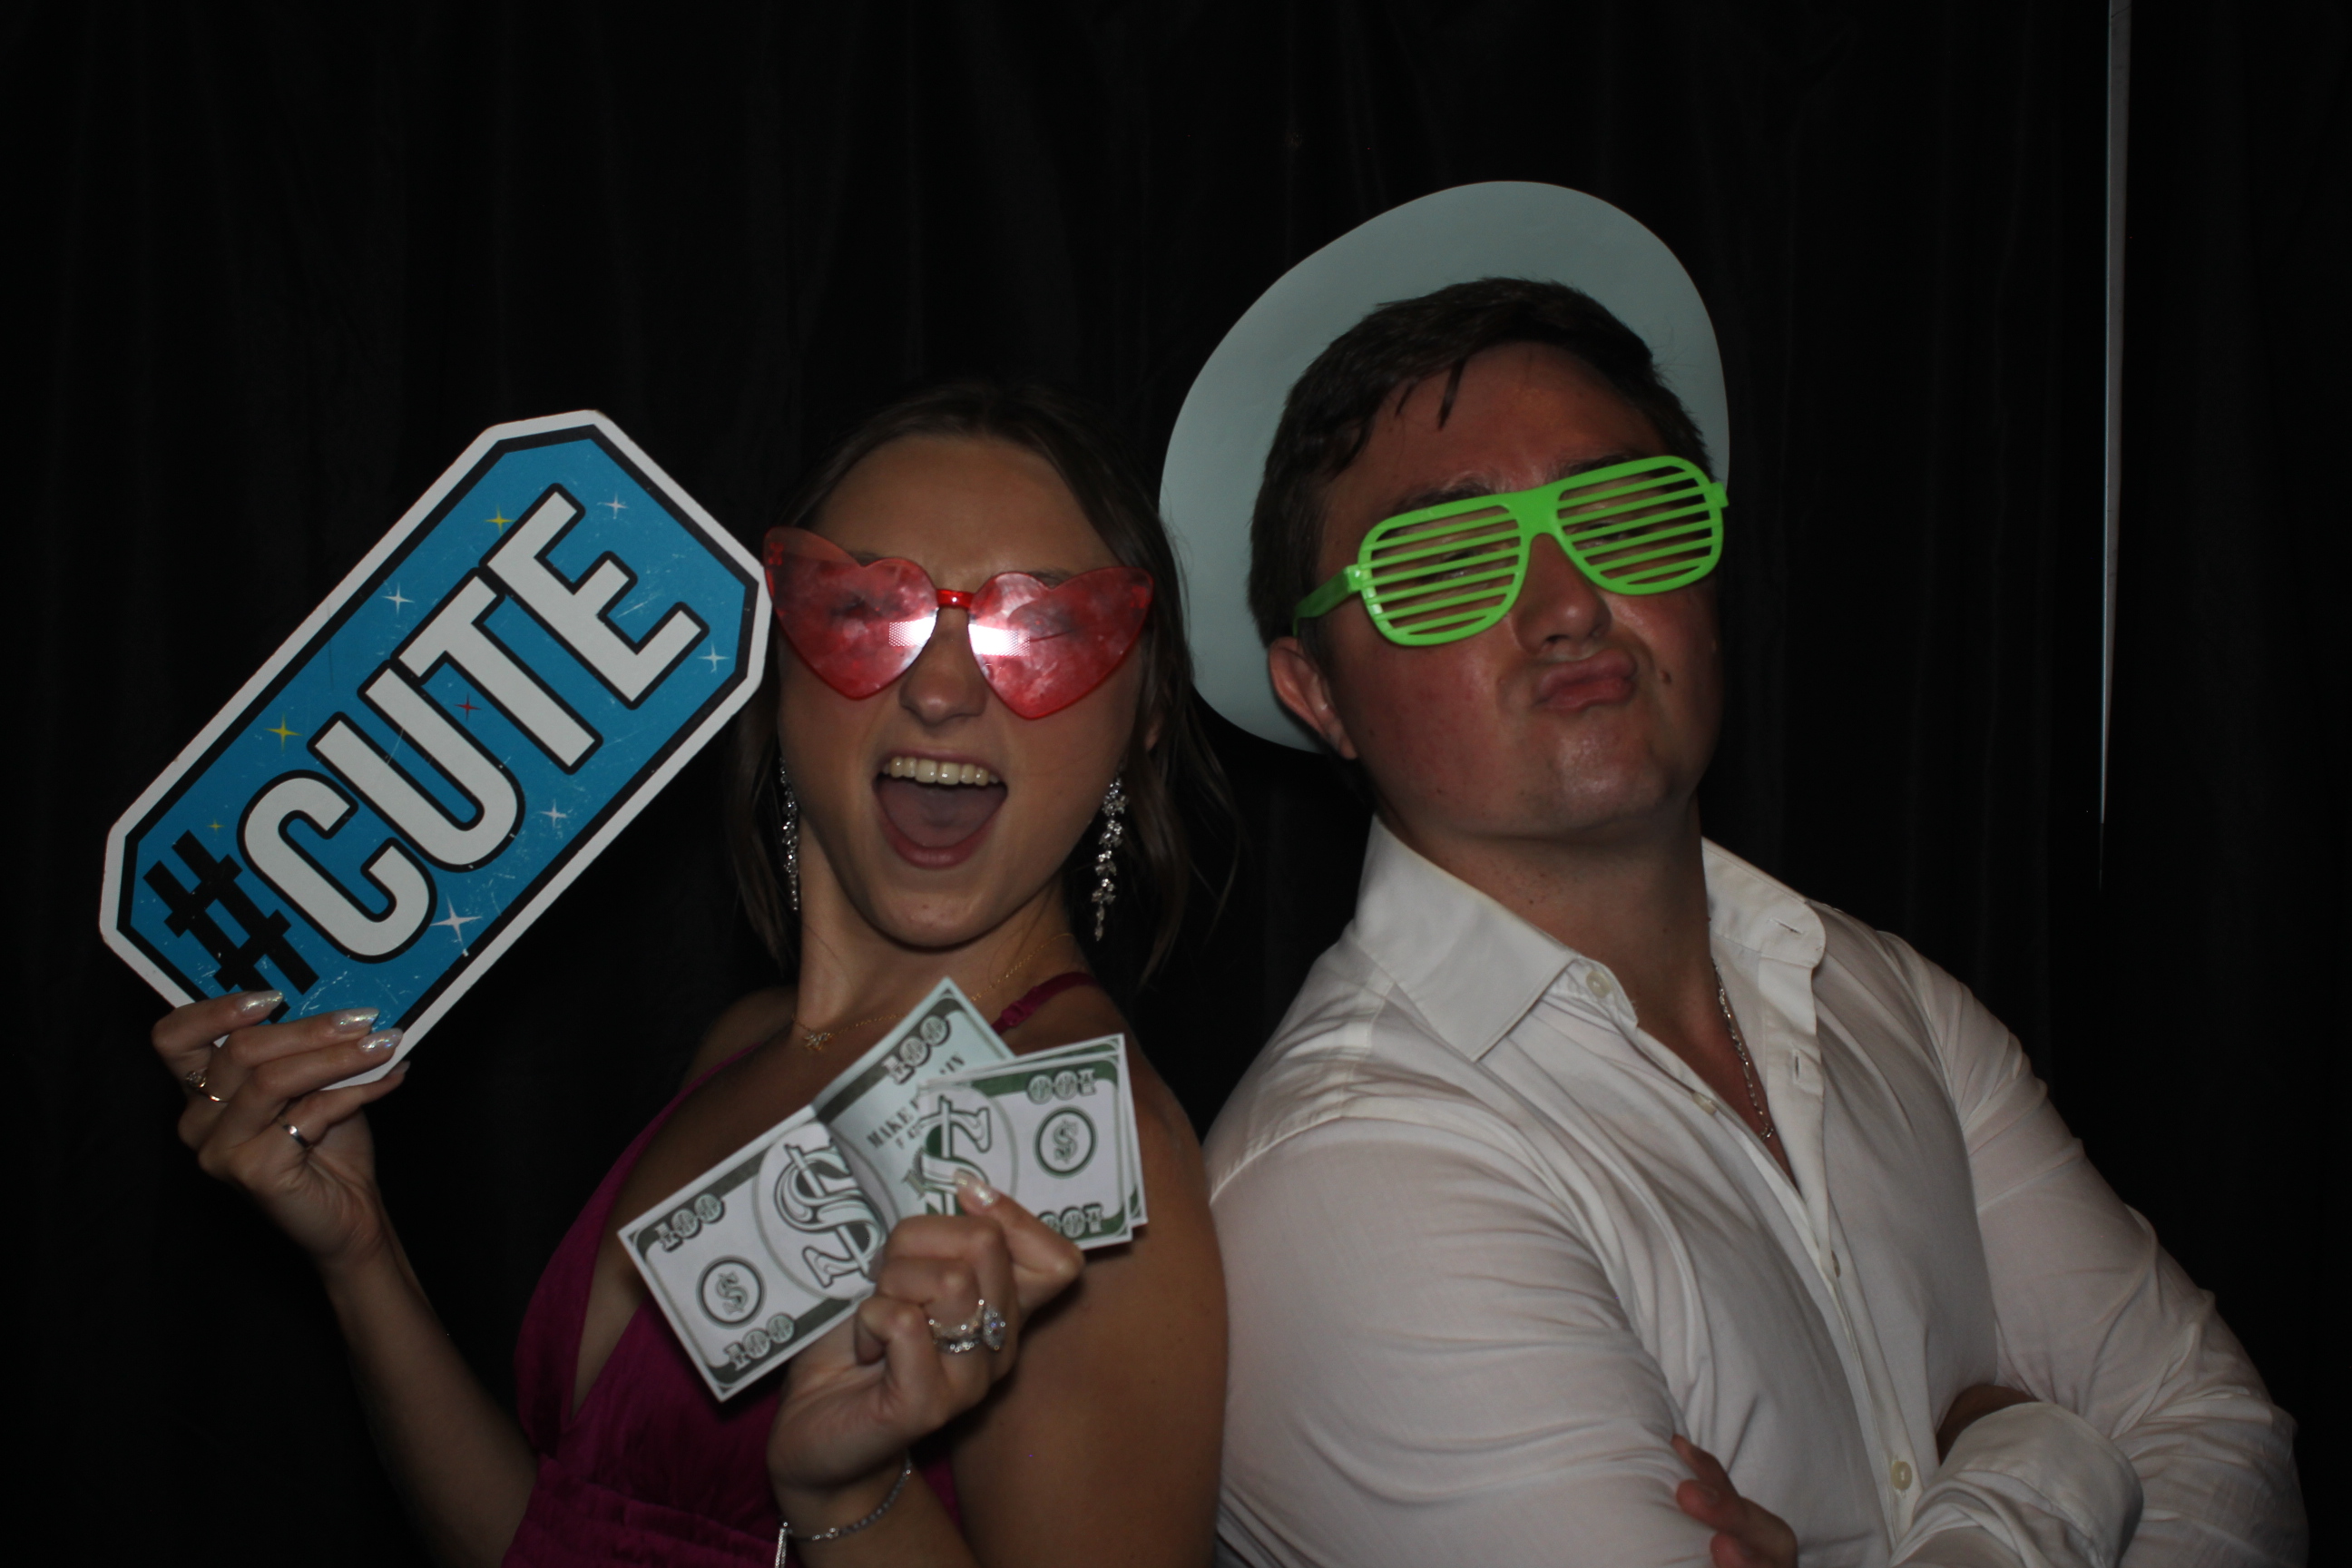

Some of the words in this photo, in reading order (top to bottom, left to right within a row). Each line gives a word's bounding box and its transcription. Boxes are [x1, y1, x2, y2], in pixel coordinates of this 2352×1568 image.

[143, 483, 710, 1024] #CUTE
[882, 1014, 951, 1086] 100
[1026, 1068, 1097, 1105] 100
[866, 1106, 915, 1149] MAKE
[655, 1193, 724, 1252] 100
[723, 1311, 795, 1371] 100
